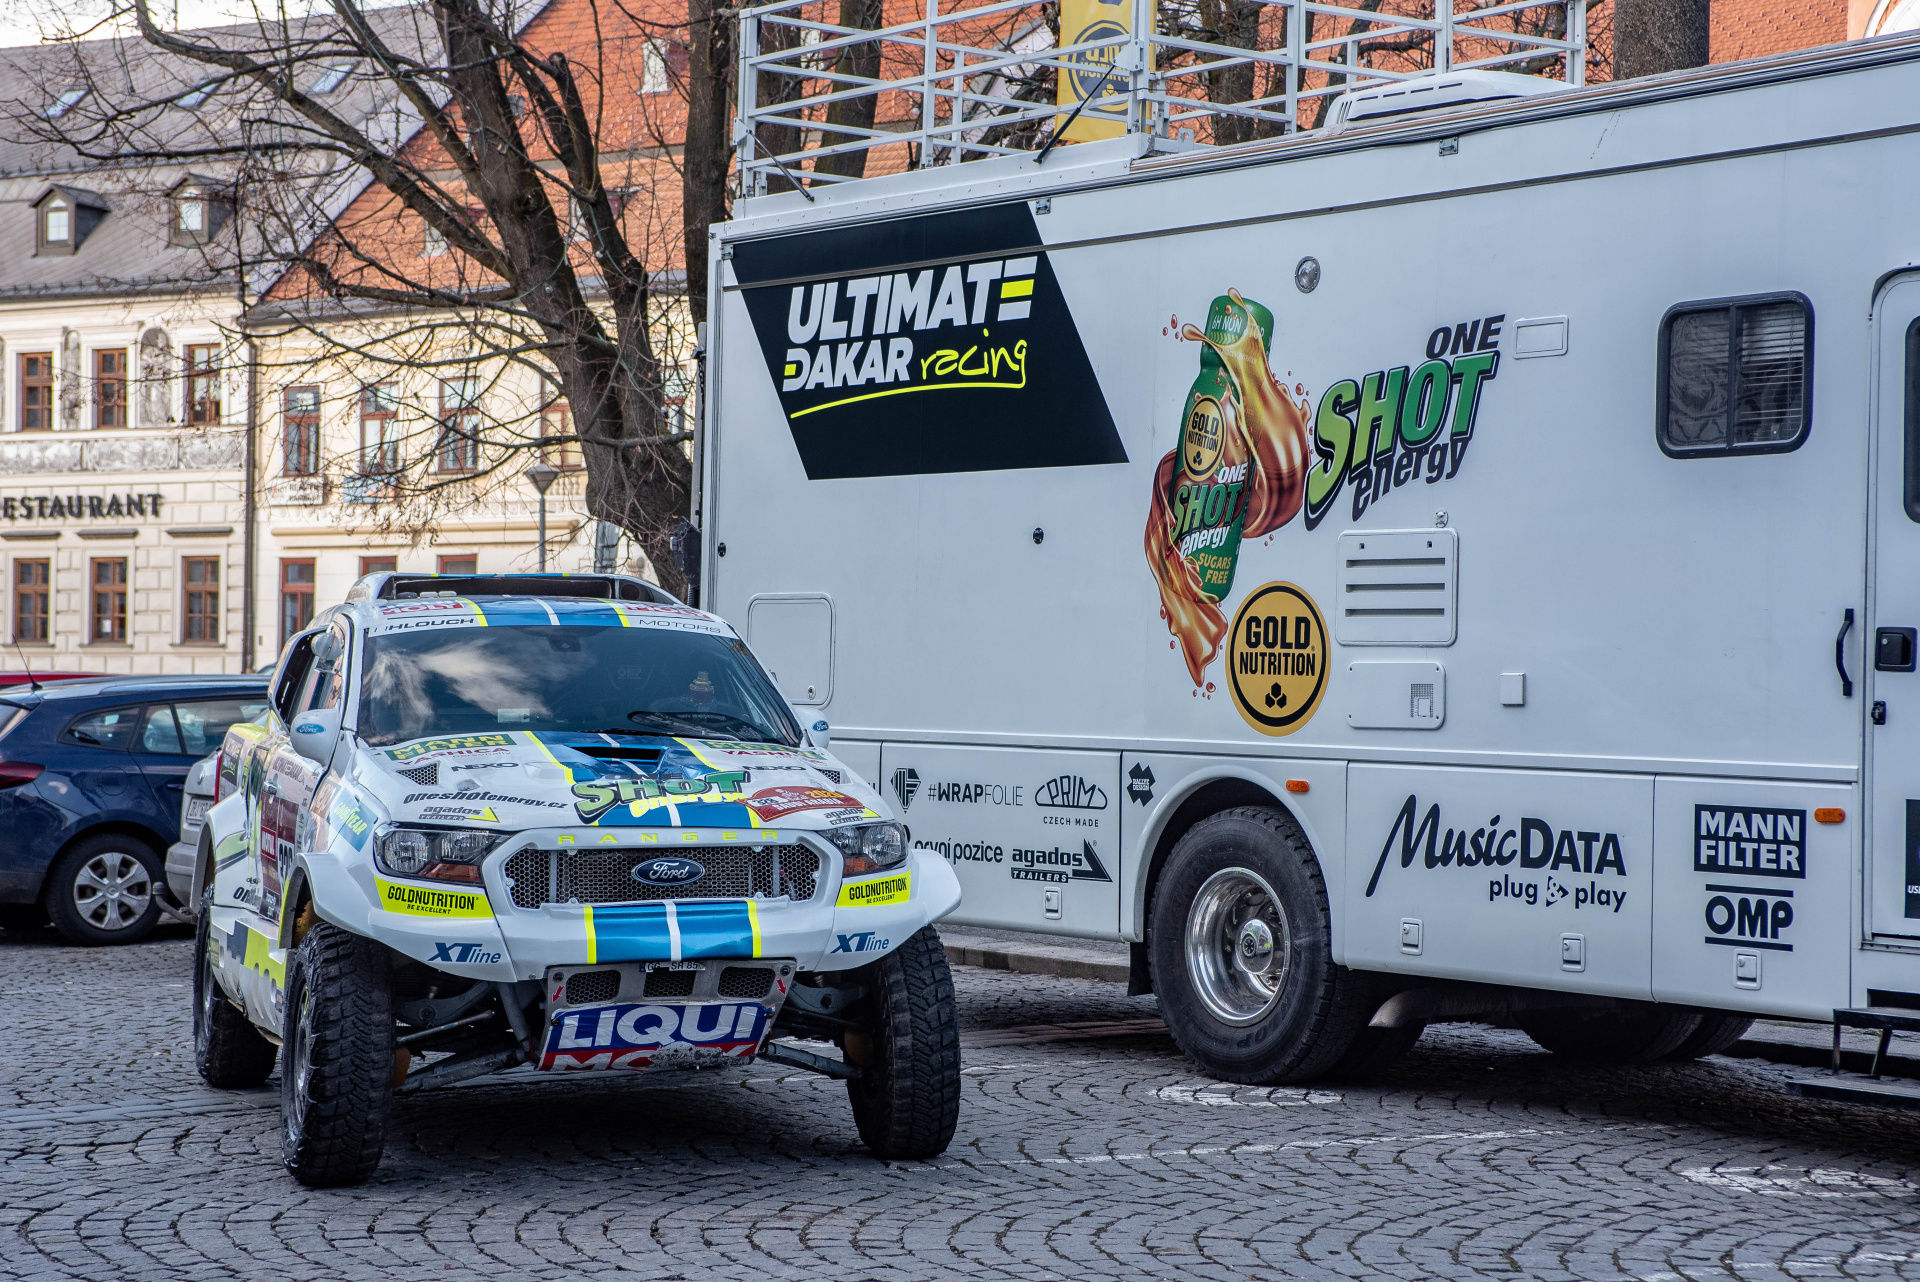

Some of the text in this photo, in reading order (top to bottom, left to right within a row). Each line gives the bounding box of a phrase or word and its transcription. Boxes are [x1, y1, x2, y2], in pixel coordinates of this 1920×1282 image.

[787, 256, 1038, 345] ULTIMATE
[1426, 314, 1506, 360] ONE
[782, 328, 1028, 392] DAKAR racing
[1191, 411, 1220, 437] GOLD
[1188, 430, 1219, 453] NUTRITION
[1304, 351, 1501, 531] SHOT
[1217, 462, 1248, 484] ONE
[1352, 437, 1469, 521] energy
[0, 493, 165, 520] ESTAURANT
[1170, 482, 1245, 542] SHOT
[1180, 526, 1230, 558] energy
[1197, 552, 1232, 570] SUGARS
[1205, 569, 1230, 585] FREE
[639, 619, 721, 634] MOTORS
[1245, 615, 1312, 649] GOLD
[1239, 651, 1316, 677] NUTRITION
[393, 735, 506, 756] MANN
[398, 747, 510, 766] YASHICA
[451, 762, 520, 772] NEXO
[402, 791, 569, 809] oneshotenergy.cz
[571, 771, 752, 824] SHOT
[927, 781, 1024, 806] #WRAPFOLIE
[1046, 774, 1097, 808] PRIM
[424, 806, 482, 816] agados
[628, 792, 747, 818] energy
[824, 808, 865, 819] agados
[1043, 815, 1099, 828] CZECH MADE
[1699, 810, 1800, 843] MANN
[557, 831, 779, 844] RANGER
[1365, 794, 1628, 898] MusicDATA
[953, 840, 1003, 865] pozice
[1012, 847, 1083, 868] agados
[1699, 839, 1801, 872] FILTER
[649, 861, 689, 883] Ford
[1012, 869, 1068, 883] TRAILERS
[387, 885, 476, 911] GOLDNUTRITION
[848, 877, 909, 901] GOLDNUTRITION
[1488, 874, 1539, 906] plug
[1574, 880, 1628, 914] play
[420, 905, 451, 914] EXCELLENT
[1704, 894, 1795, 940] OMP
[428, 941, 502, 964] XTline
[831, 931, 890, 954] XTline
[557, 1005, 758, 1049] LIQUI
